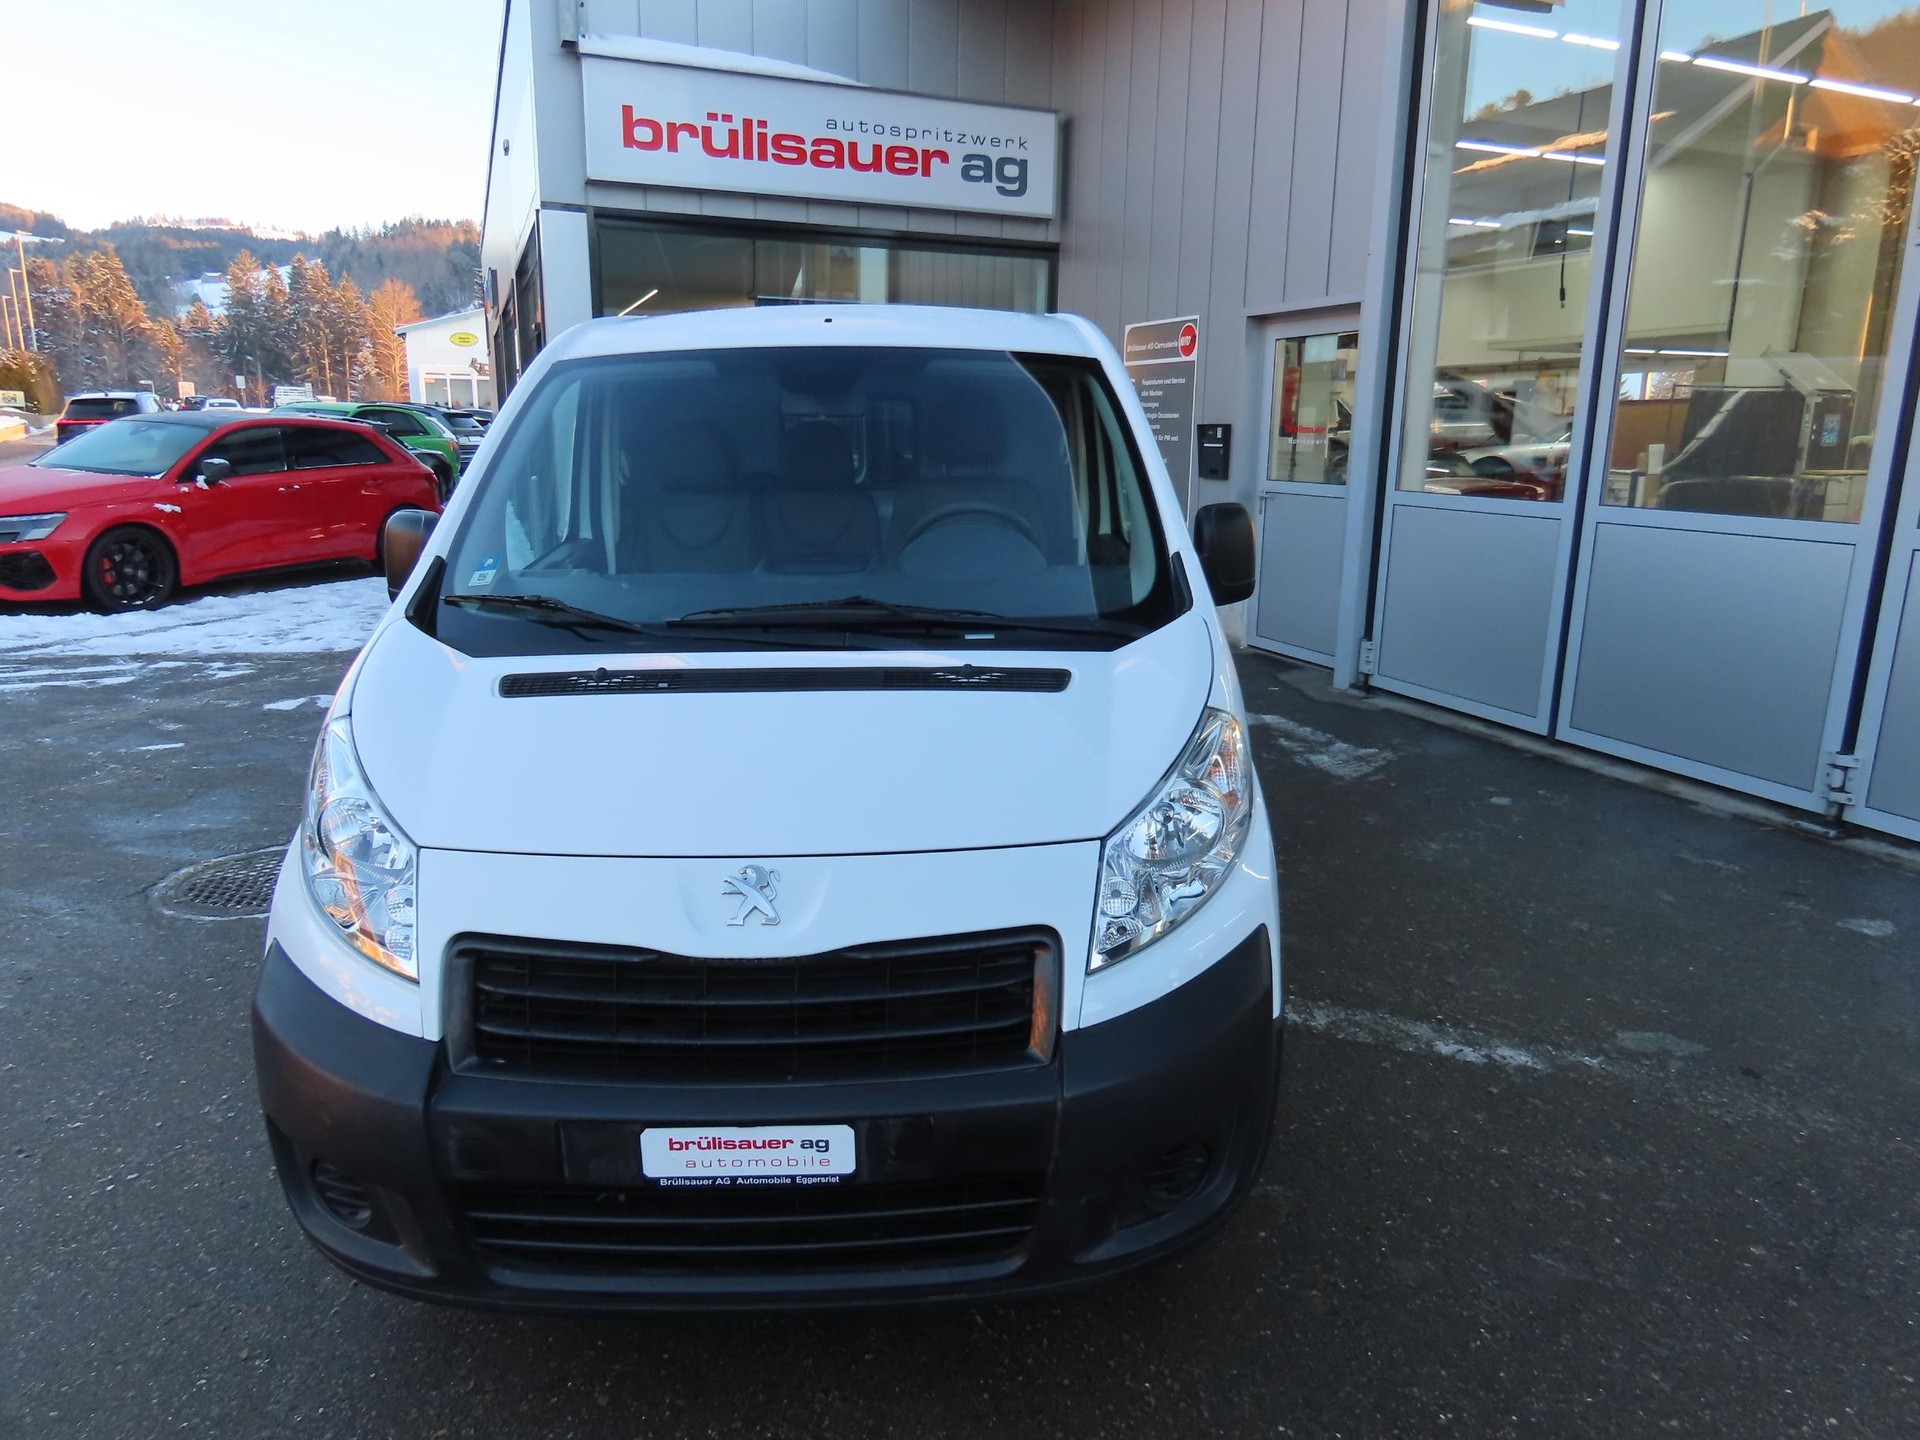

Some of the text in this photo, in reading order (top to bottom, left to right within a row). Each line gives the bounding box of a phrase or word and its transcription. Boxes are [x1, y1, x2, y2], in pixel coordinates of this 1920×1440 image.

[826, 117, 1029, 151] autospritzwerk
[621, 104, 1029, 197] brülisauer ag
[668, 1136, 830, 1153] brülisauer ag
[685, 1156, 831, 1169] automobile
[660, 1175, 840, 1186] Brülisauer AG Automobile Eggersriet
